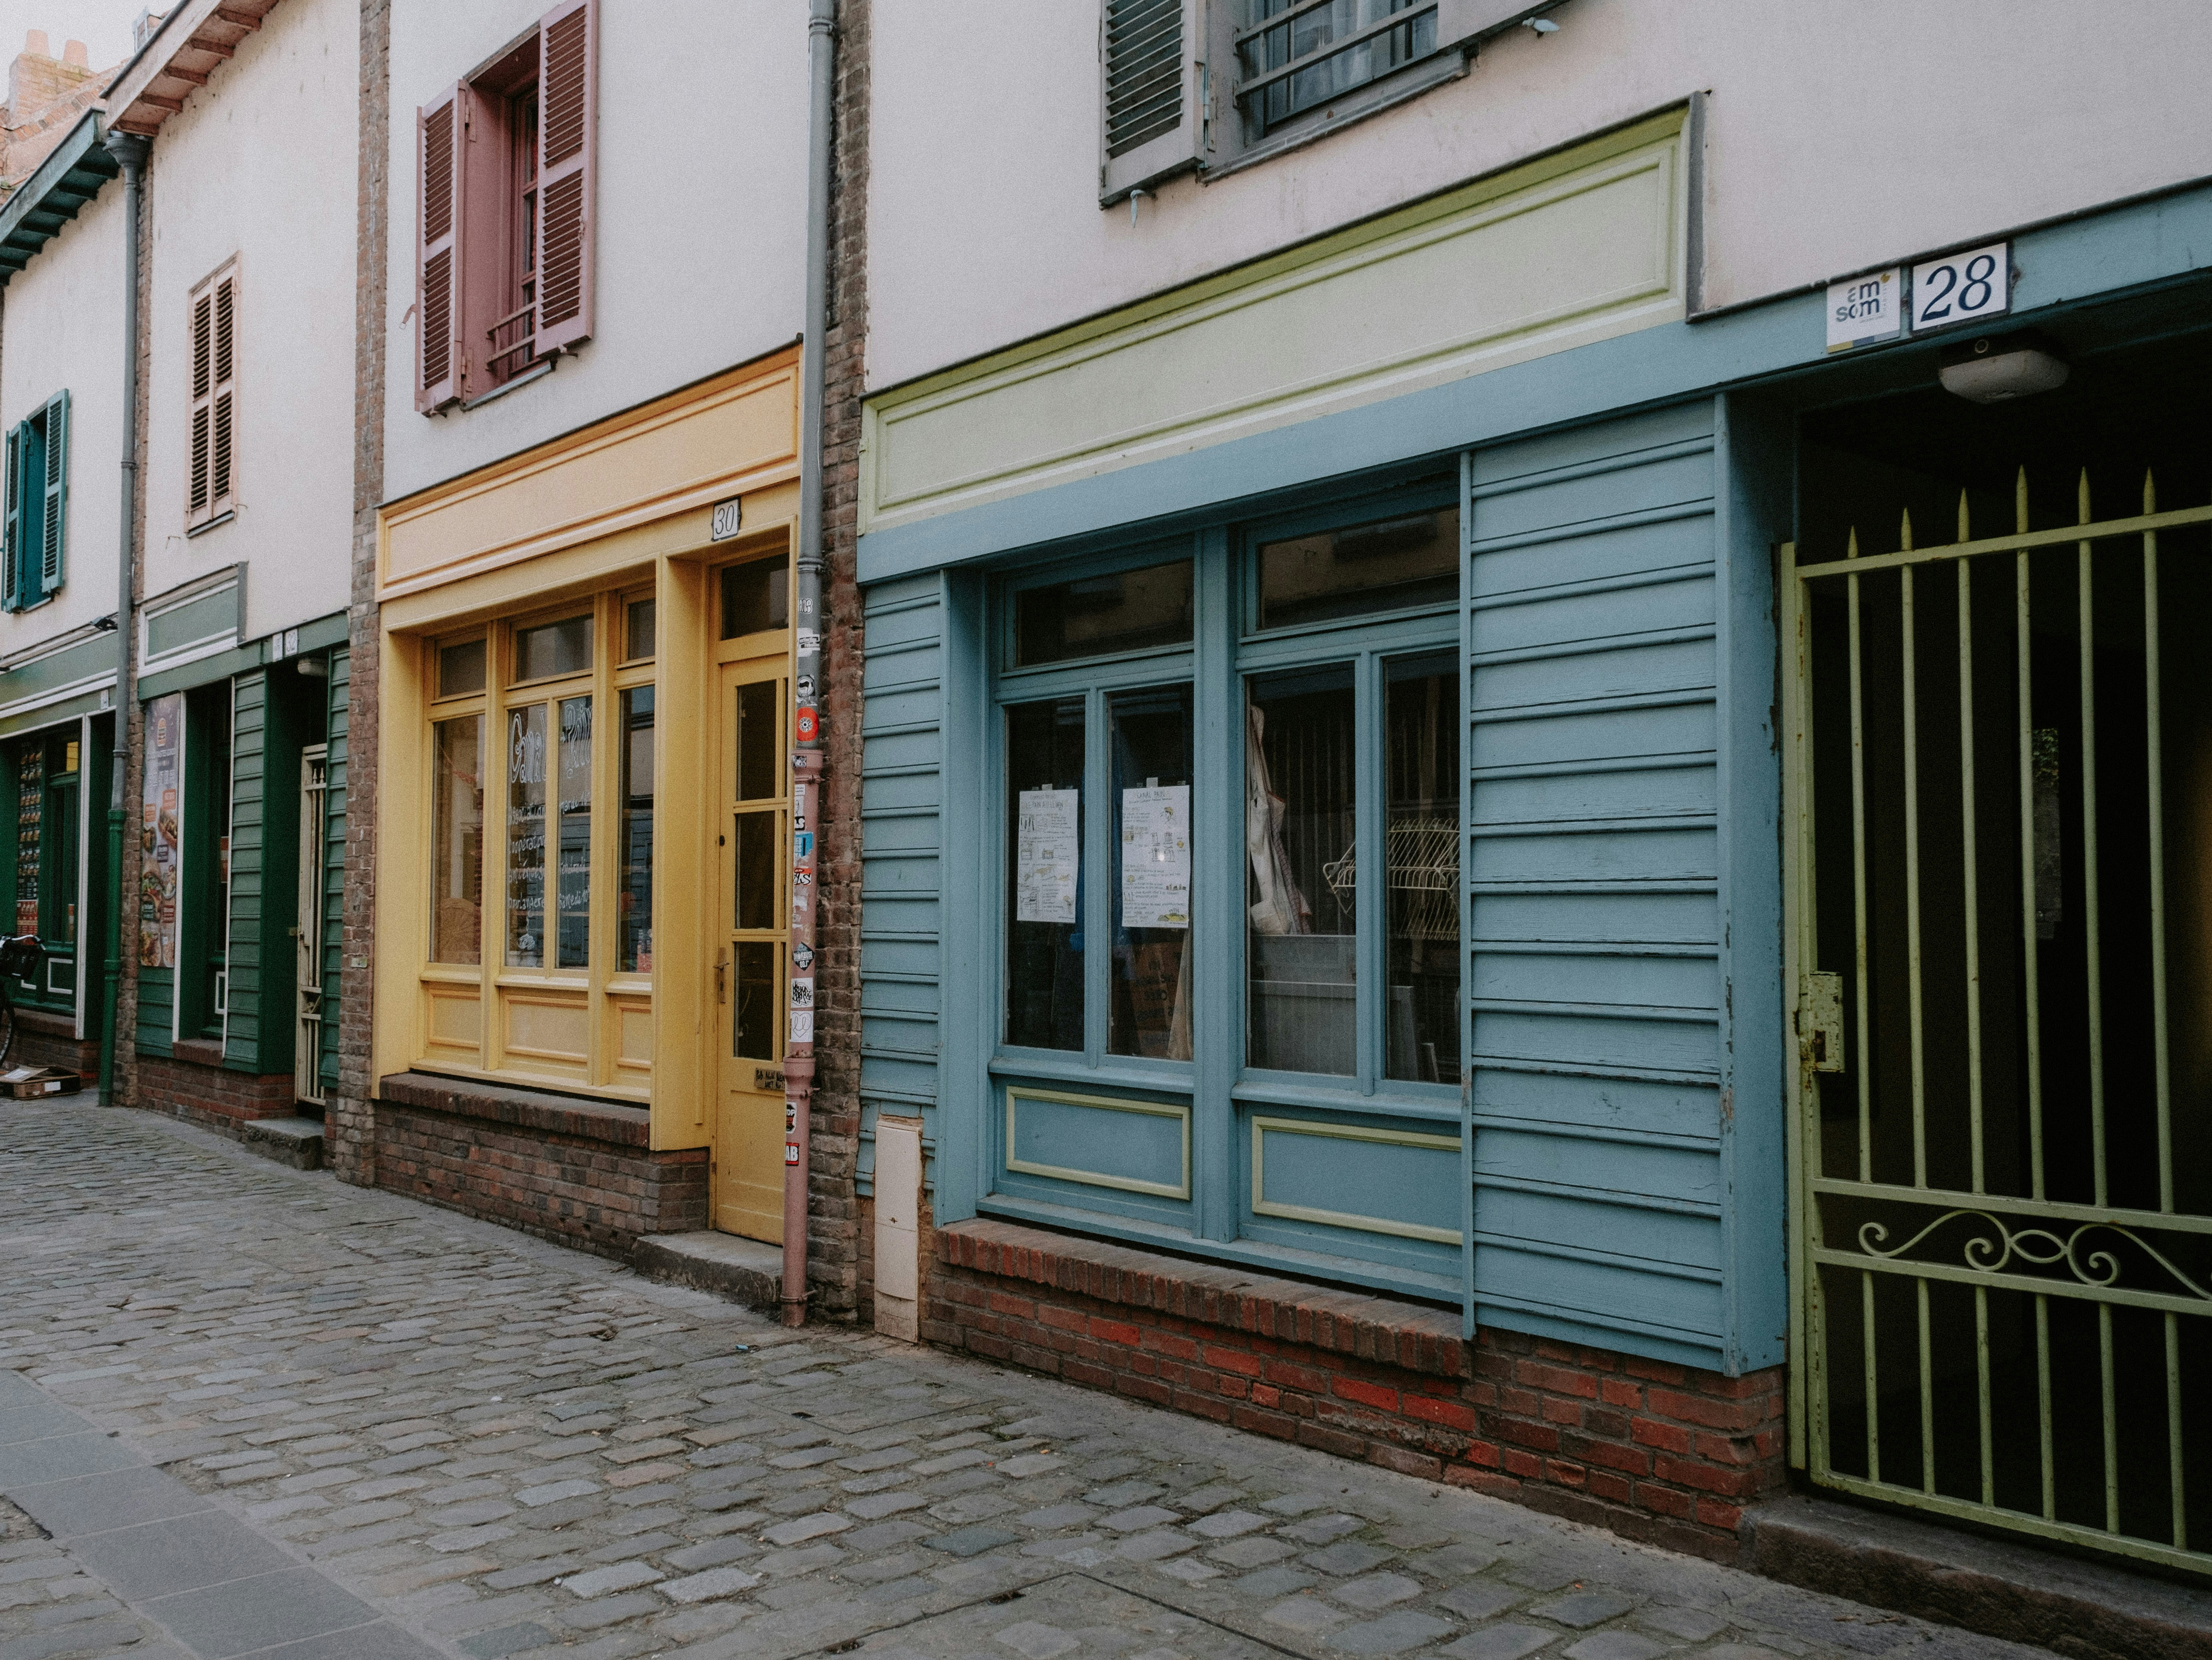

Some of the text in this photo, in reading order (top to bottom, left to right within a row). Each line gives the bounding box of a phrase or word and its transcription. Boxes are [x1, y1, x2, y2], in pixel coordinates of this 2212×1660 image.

[1921, 255, 1996, 322] 28
[715, 505, 735, 535] 30
[287, 632, 296, 652] 32
[785, 1146, 798, 1161] AB
